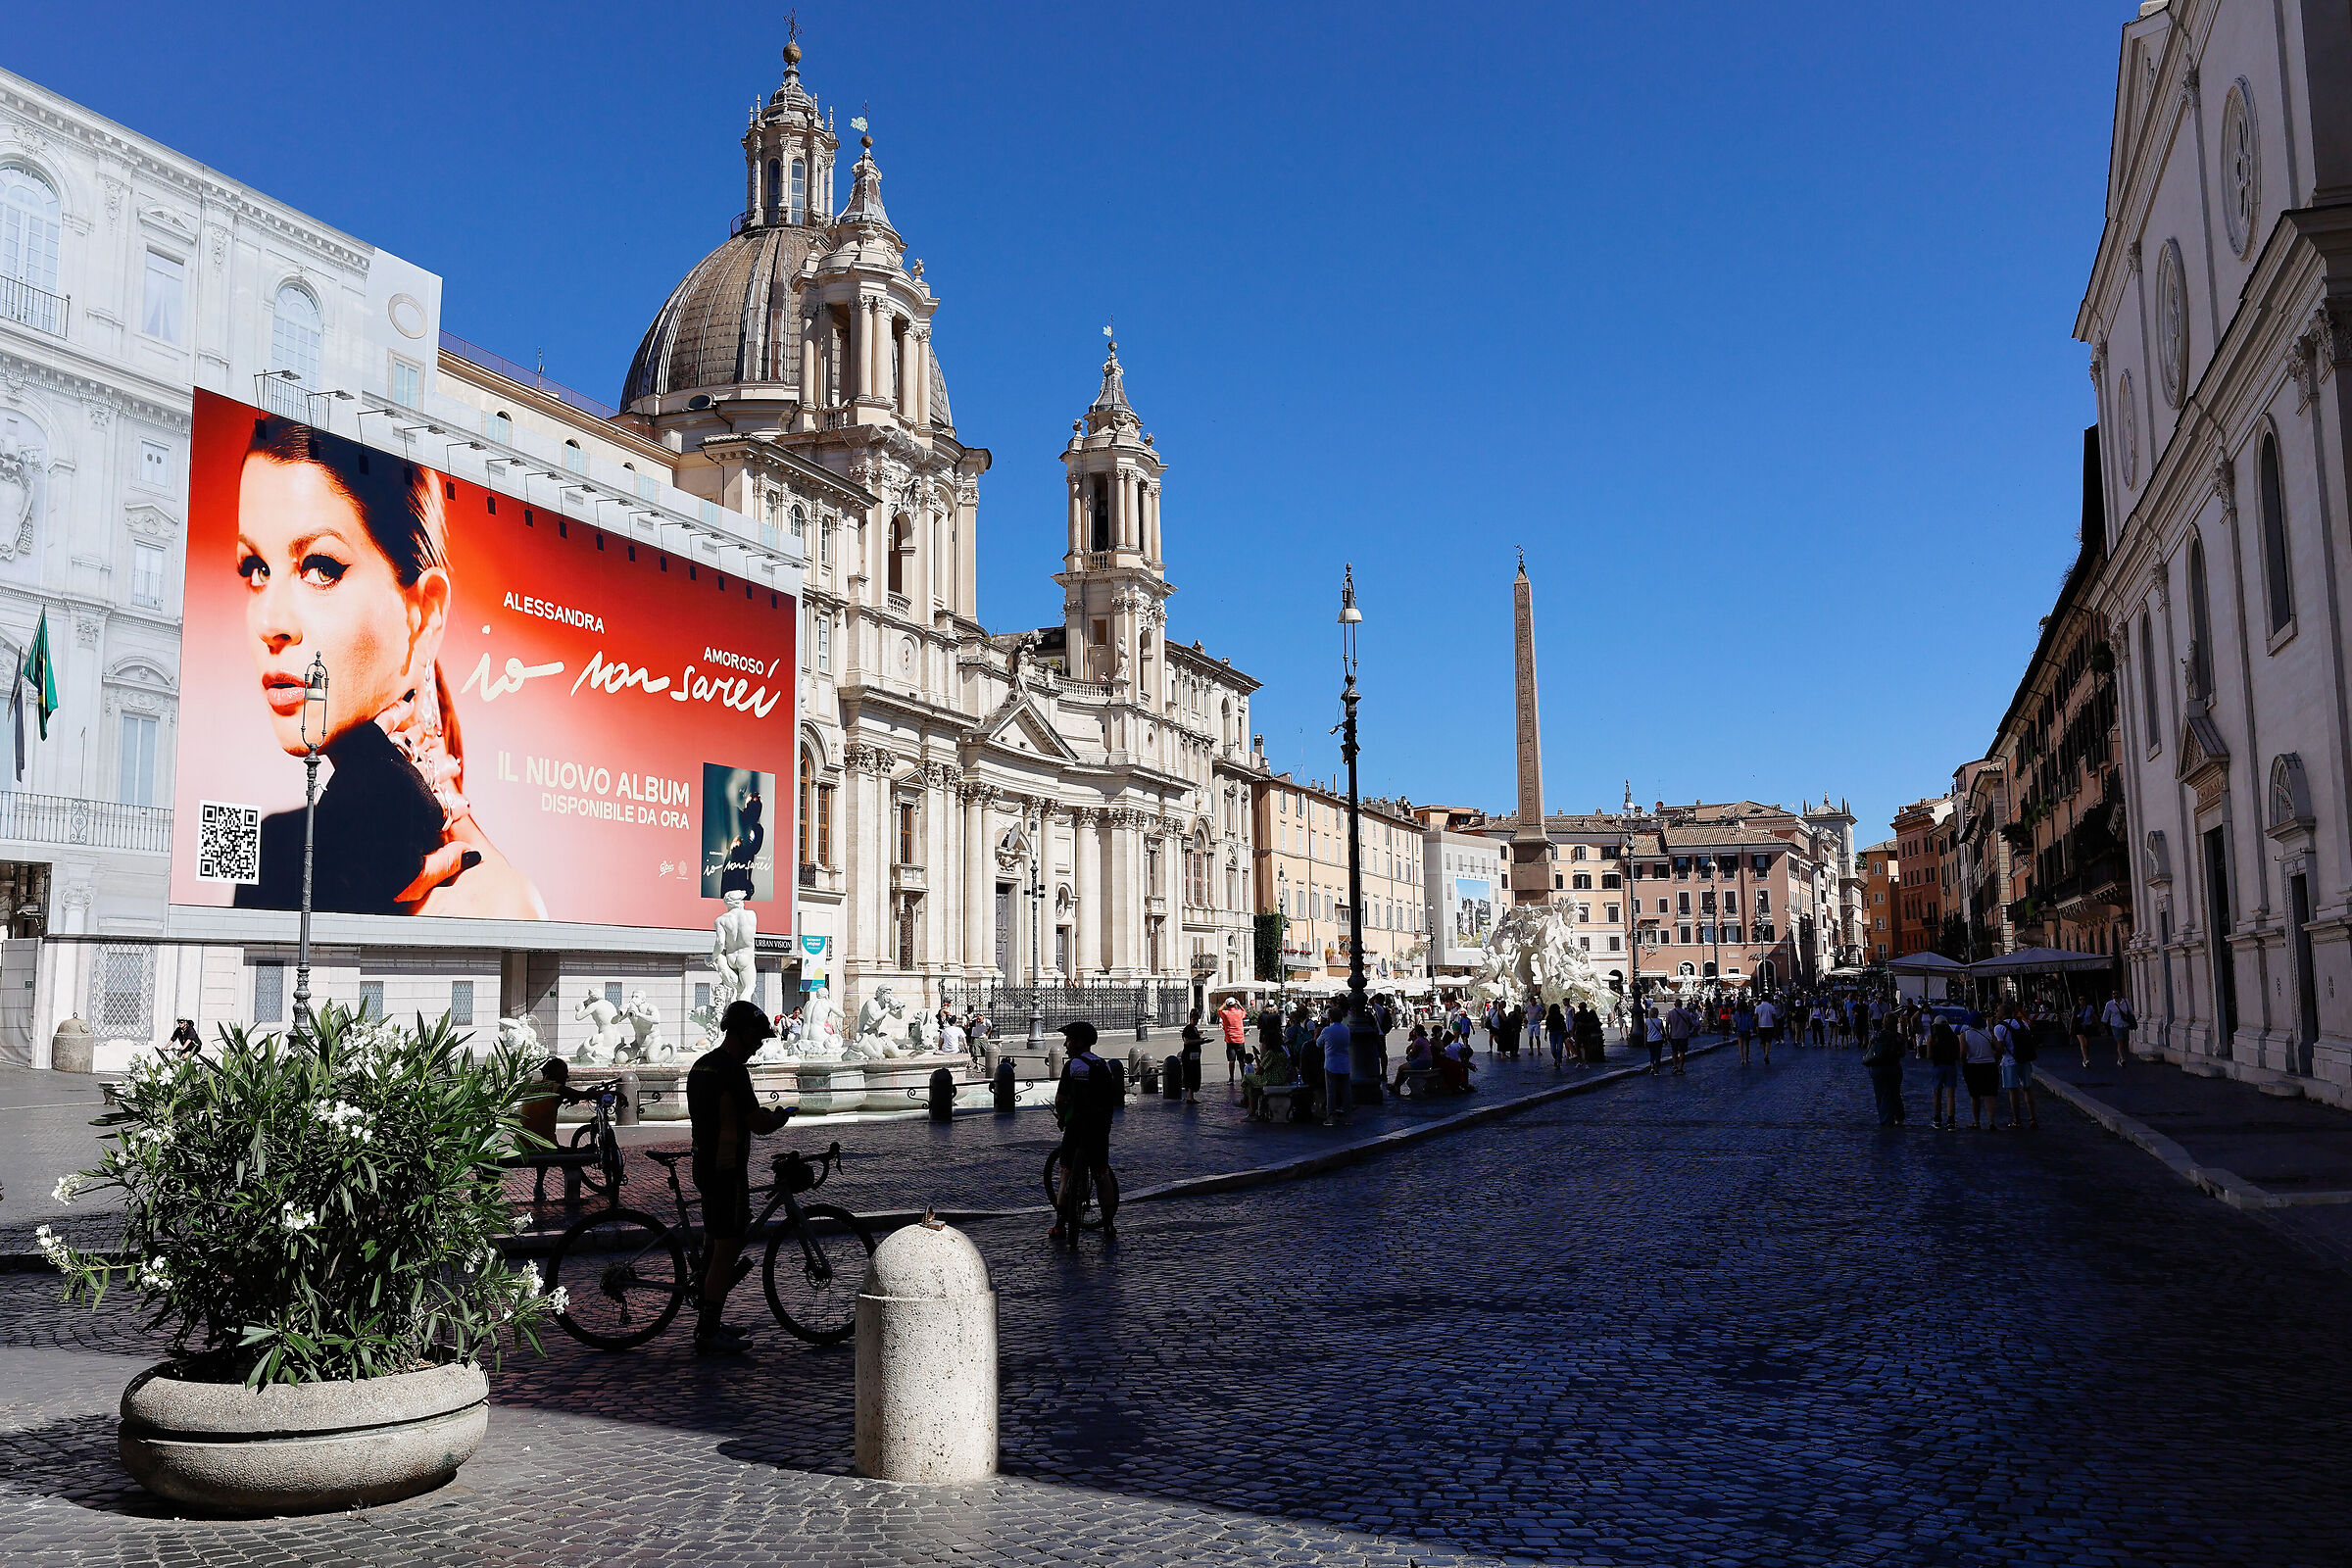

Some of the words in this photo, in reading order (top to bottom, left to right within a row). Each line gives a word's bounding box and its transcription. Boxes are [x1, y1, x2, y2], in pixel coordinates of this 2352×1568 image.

[503, 591, 606, 635] ALESSANDRA
[460, 624, 565, 703] io
[569, 650, 671, 698] non
[669, 658, 781, 718] sarei
[703, 646, 764, 675] AMOROSO
[497, 750, 519, 783] IL
[525, 755, 612, 796] NUOVO
[615, 771, 690, 808] ALBUM
[540, 792, 635, 824] DISPONIBILE
[637, 806, 658, 827] DA
[660, 809, 690, 831] ORA
[755, 939, 774, 949] URBAN
[773, 940, 792, 950] VISION
